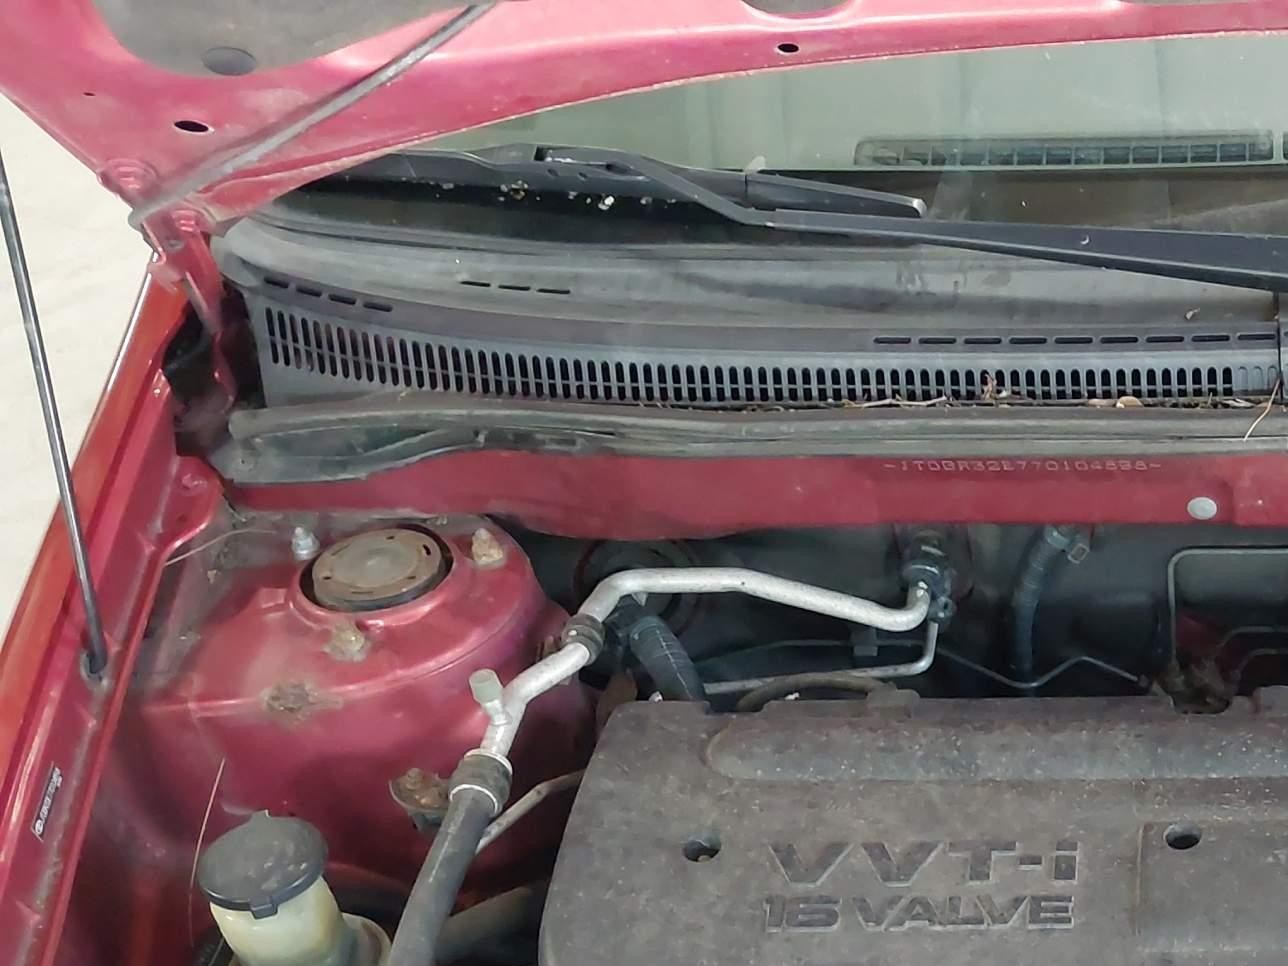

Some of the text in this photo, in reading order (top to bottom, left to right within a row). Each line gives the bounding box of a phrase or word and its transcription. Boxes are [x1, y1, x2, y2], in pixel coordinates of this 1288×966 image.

[768, 840, 1080, 888] VVT-i
[762, 894, 1075, 933] 16 VALVE
